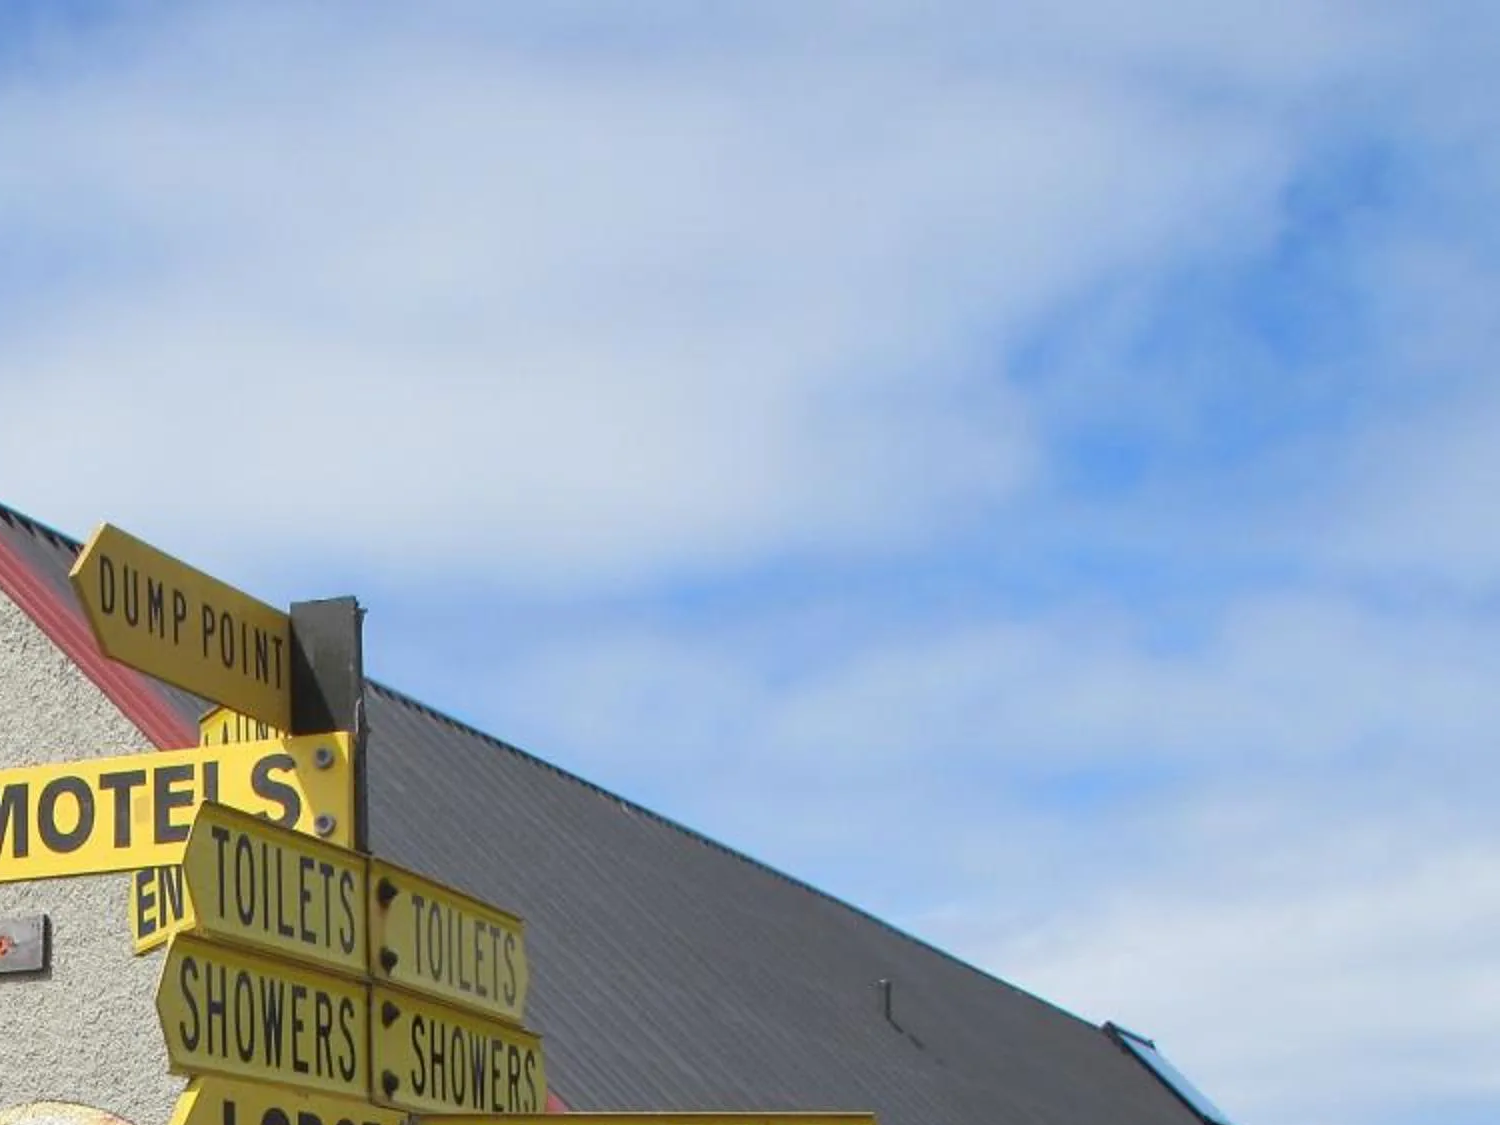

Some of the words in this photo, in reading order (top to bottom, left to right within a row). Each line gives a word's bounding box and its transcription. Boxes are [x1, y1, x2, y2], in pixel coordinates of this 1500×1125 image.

[99, 555, 187, 646] DUMP
[202, 602, 283, 690] POINT
[211, 825, 356, 954] TOILETS
[411, 894, 517, 1008] TOILETS
[179, 955, 356, 1083] SHOWERS
[411, 1013, 537, 1113] SHOWERS
